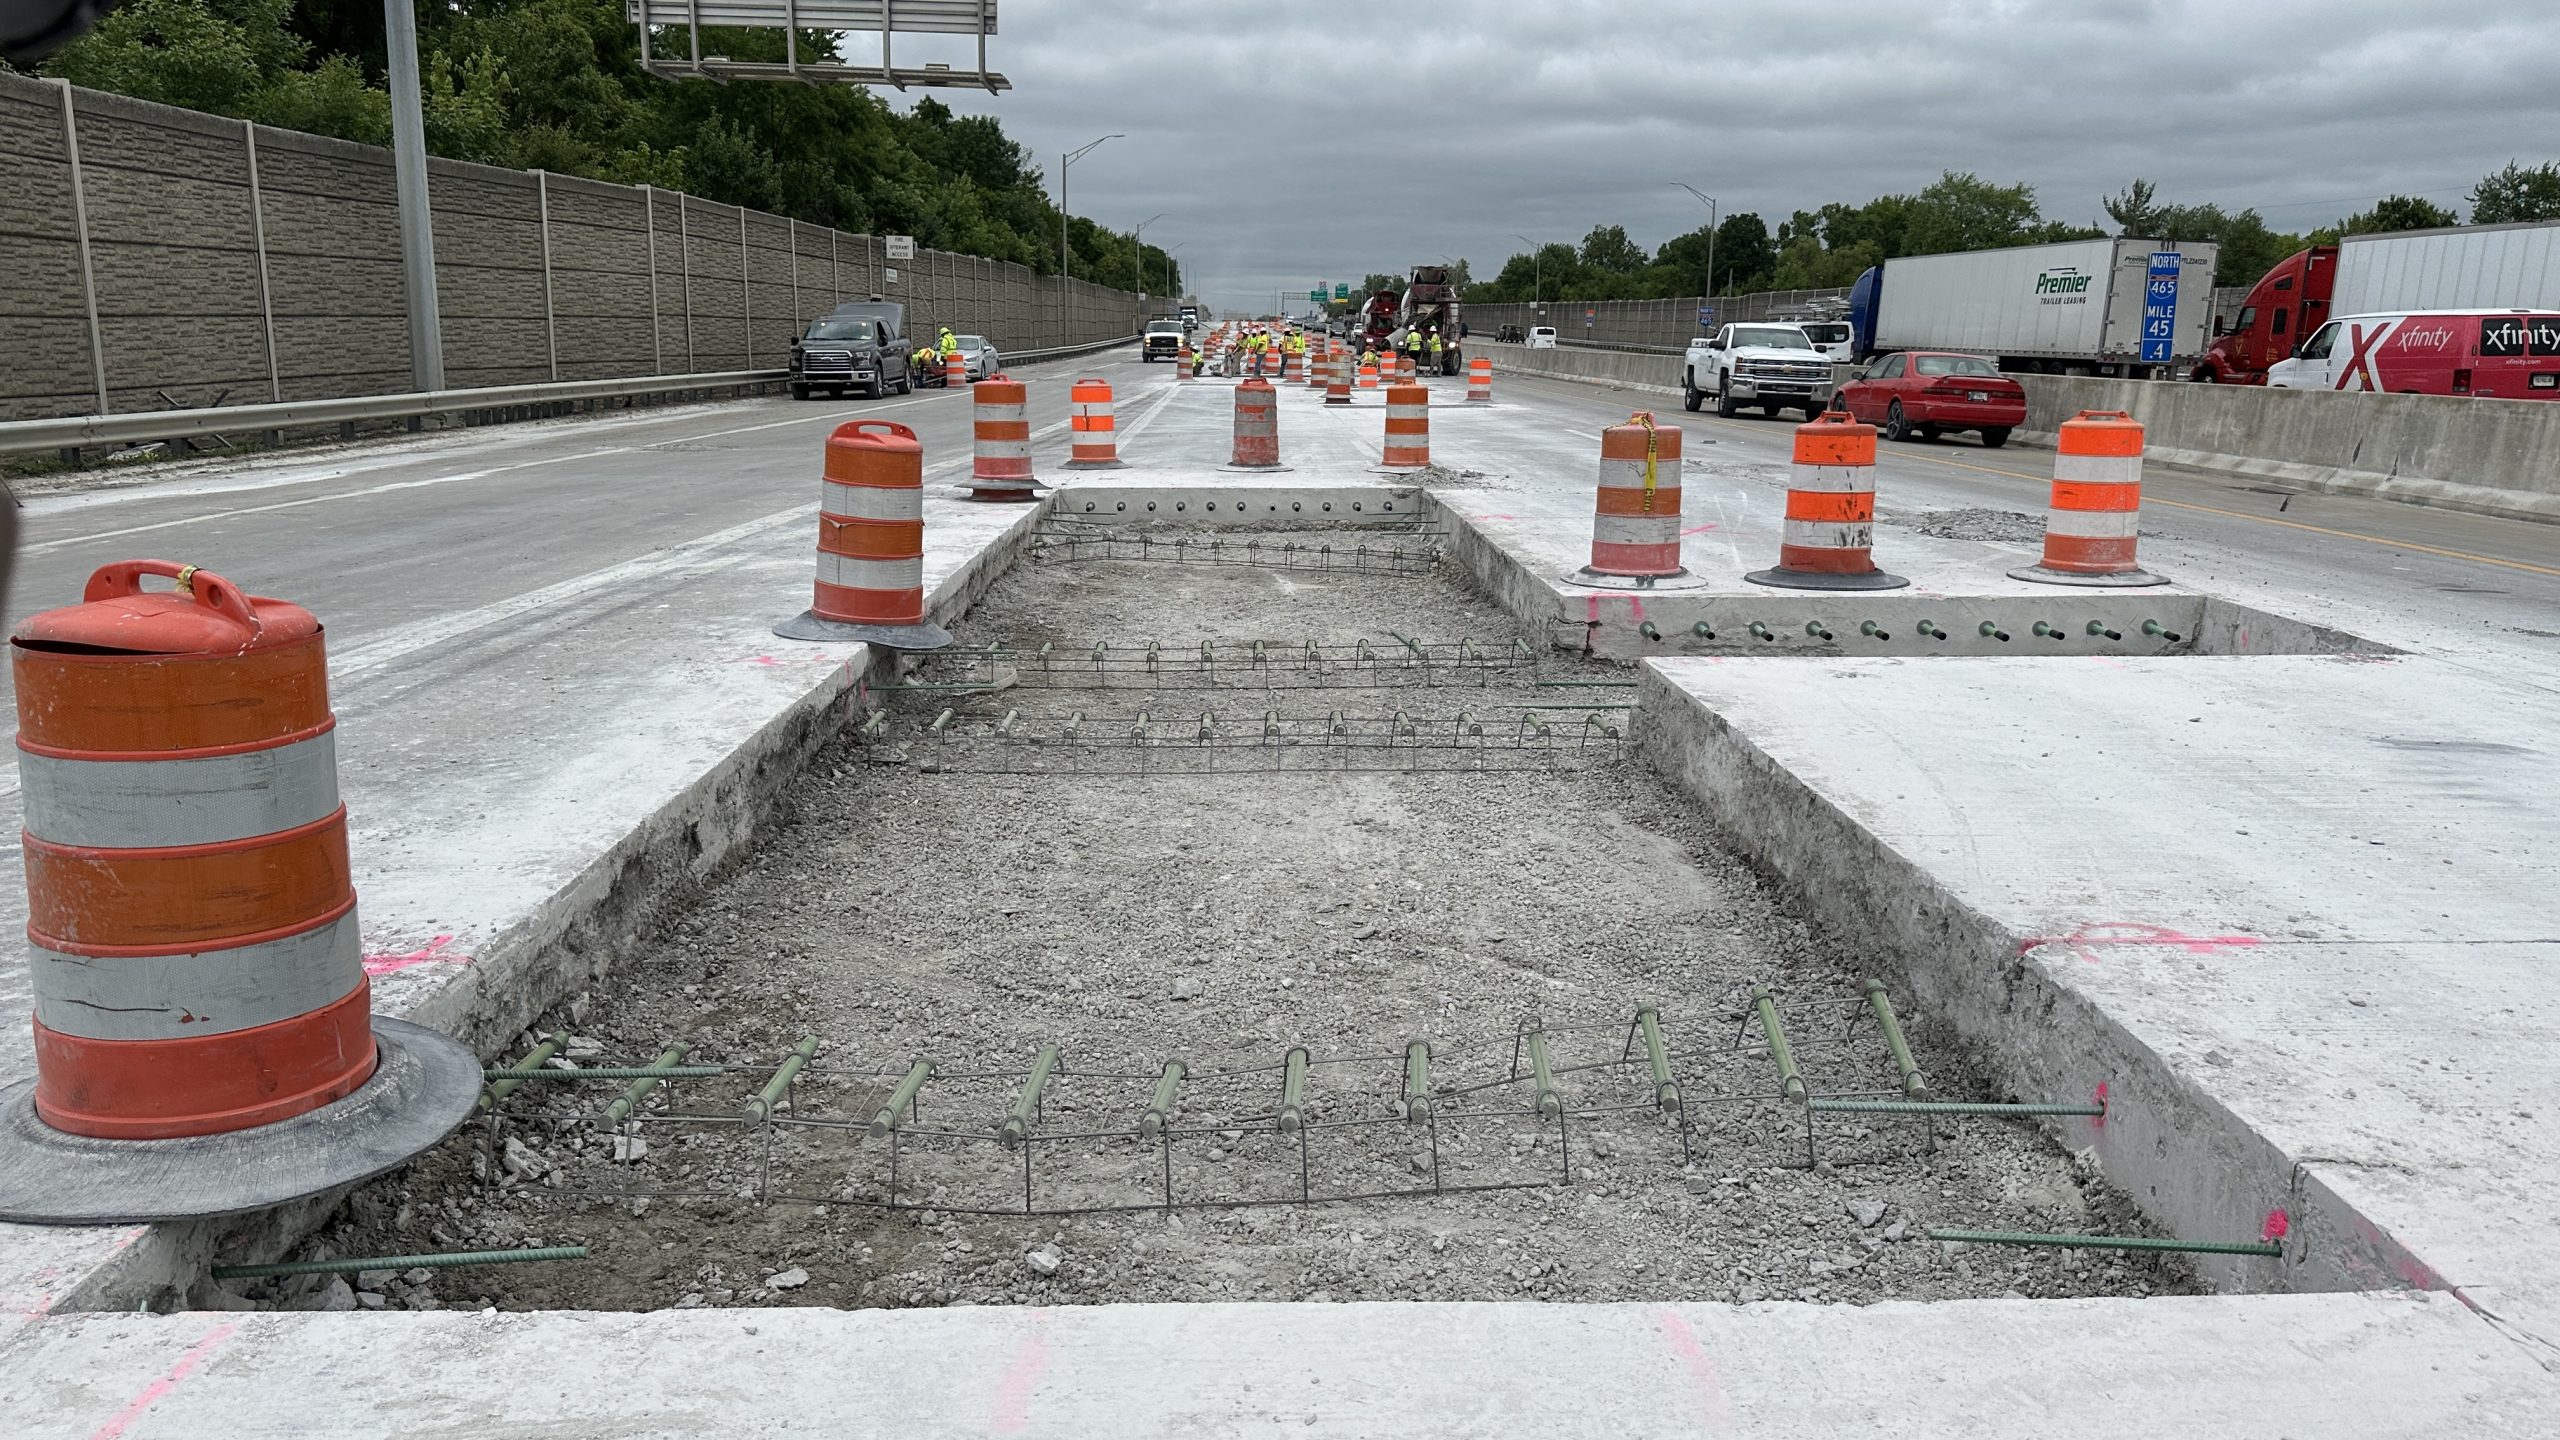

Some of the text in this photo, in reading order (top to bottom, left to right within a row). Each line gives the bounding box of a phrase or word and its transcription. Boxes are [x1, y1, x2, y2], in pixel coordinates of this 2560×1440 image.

[2151, 254, 2180, 269] NORTH
[2035, 272, 2092, 294] Premier
[2151, 281, 2175, 294] 465
[2040, 296, 2087, 305] TRAILER LEASING
[2147, 305, 2174, 318] MILE
[2149, 320, 2169, 336] 45
[2397, 325, 2454, 352] xfinity
[2485, 322, 2560, 351] xfinity
[2505, 358, 2541, 366] xfinity.com
